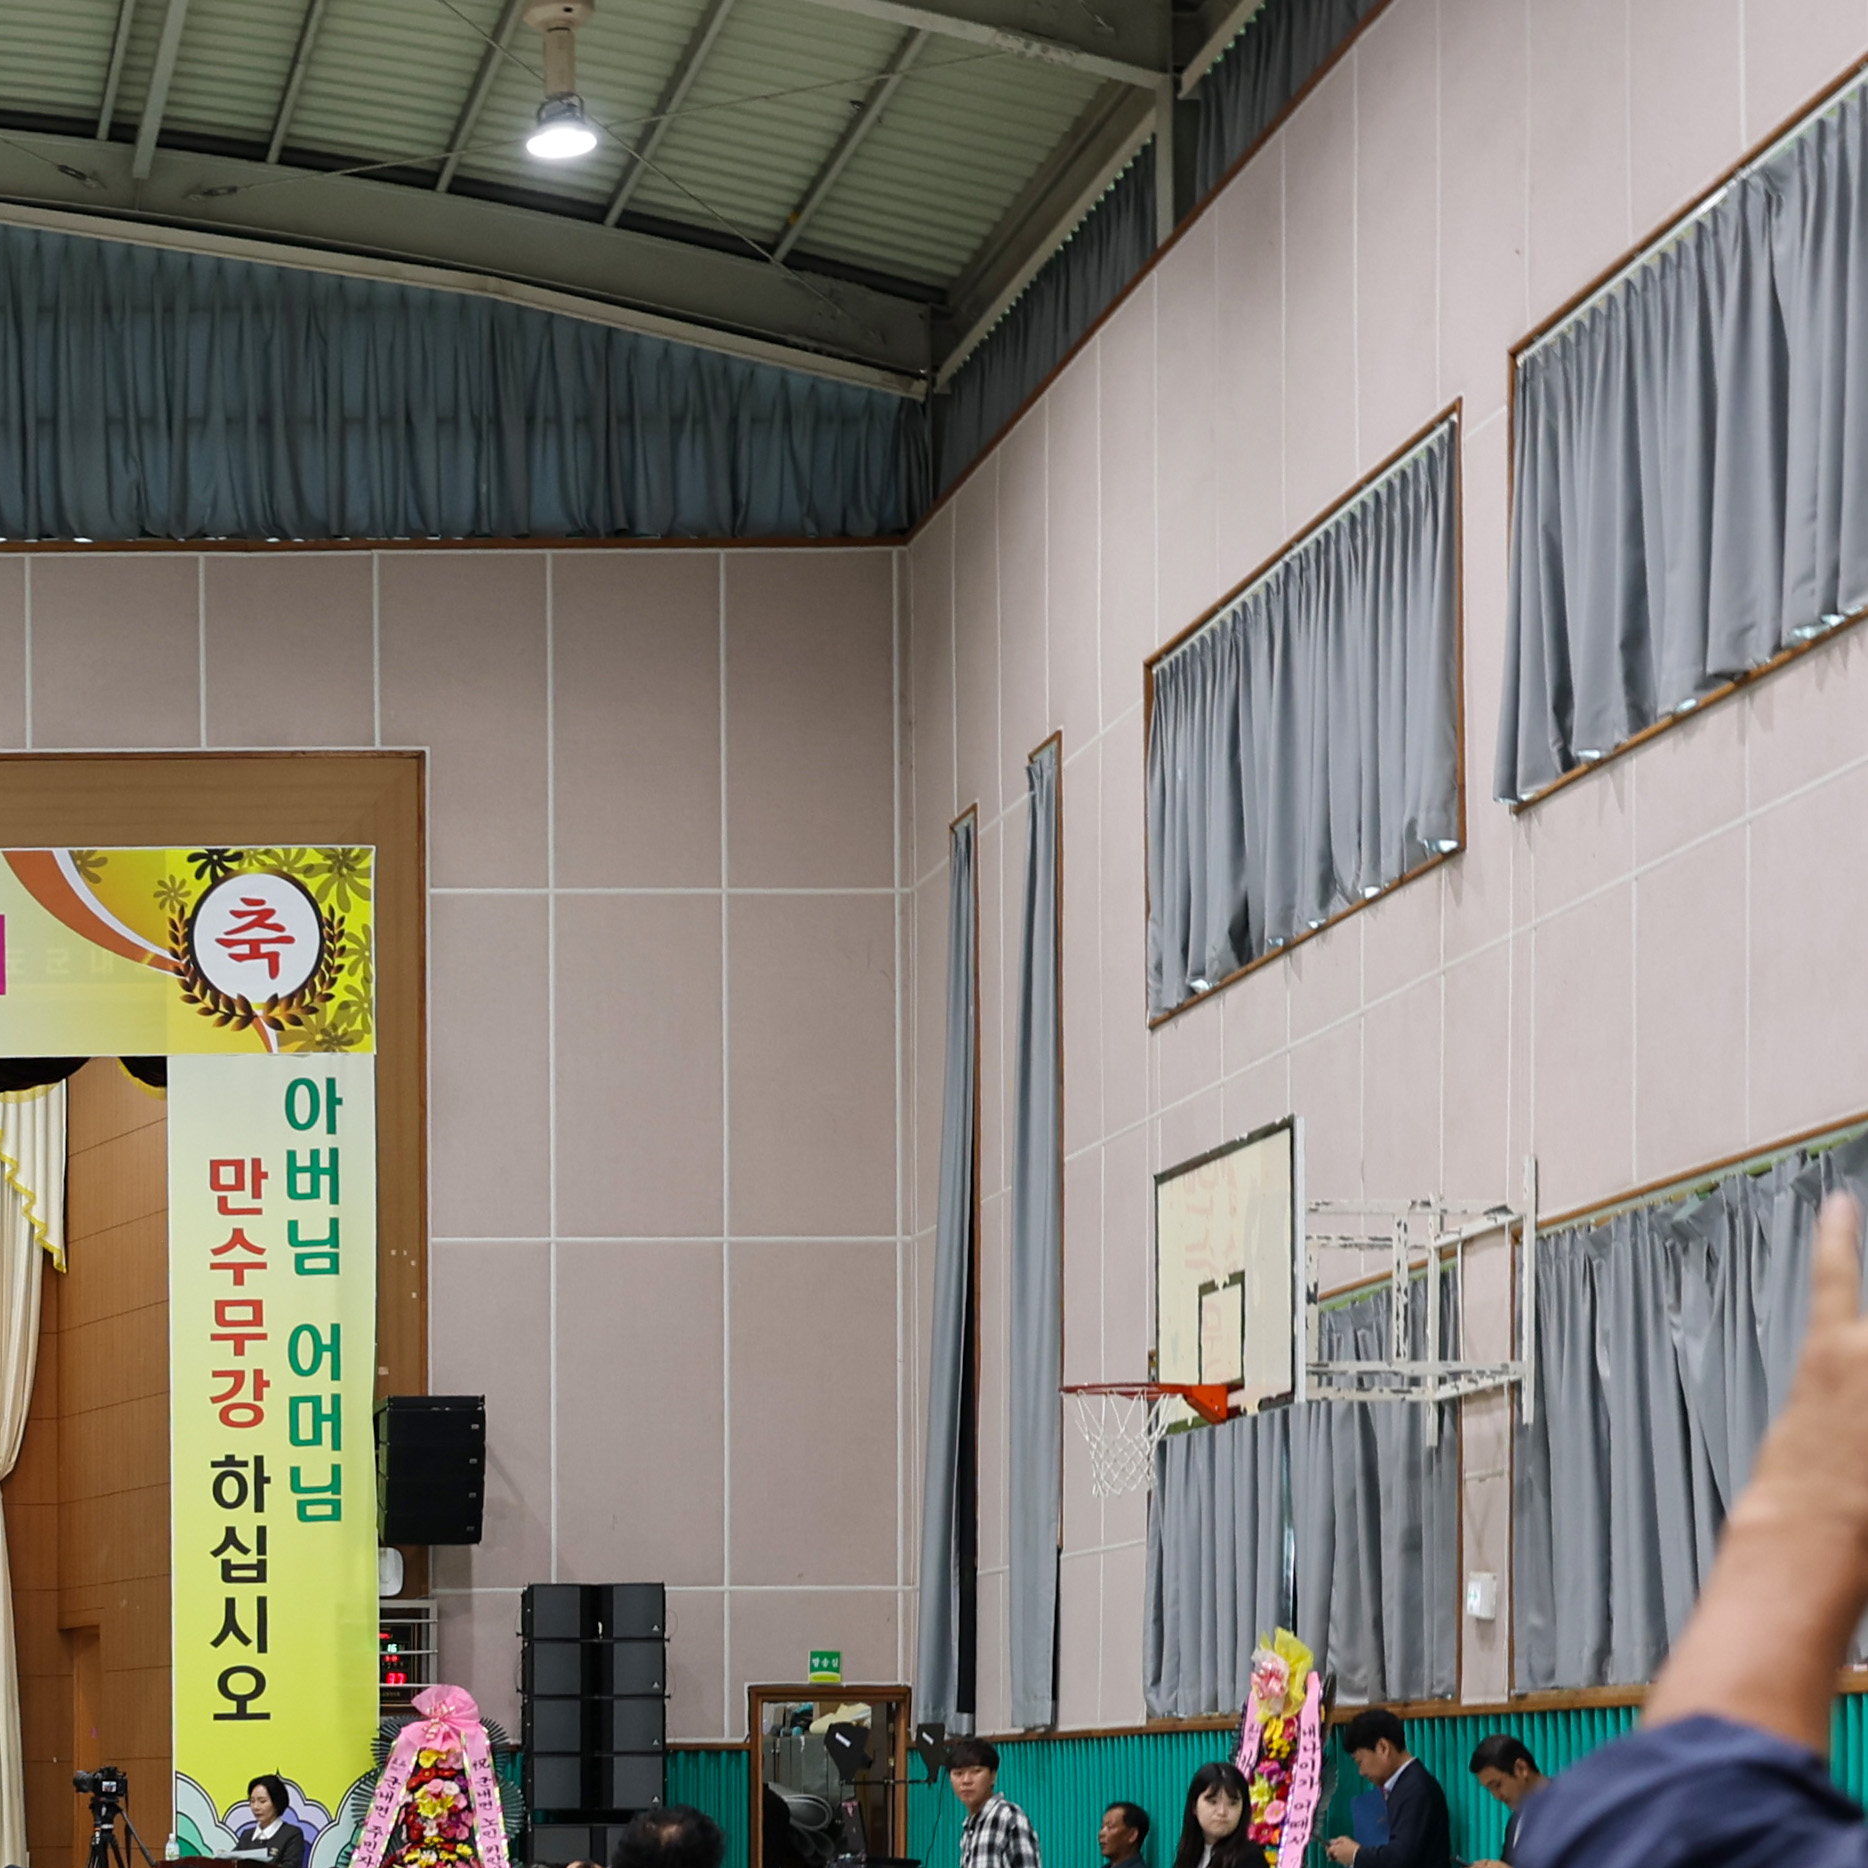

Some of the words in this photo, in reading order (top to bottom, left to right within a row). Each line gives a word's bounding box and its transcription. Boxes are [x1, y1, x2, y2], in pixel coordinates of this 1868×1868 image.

[214, 896, 298, 982] 축
[285, 1077, 343, 1276] 아버님
[210, 1158, 270, 1428] 만수무강
[288, 1323, 342, 1522] 어머님
[210, 1454, 271, 1721] 하십시오
[374, 1776, 401, 1818] 군내면
